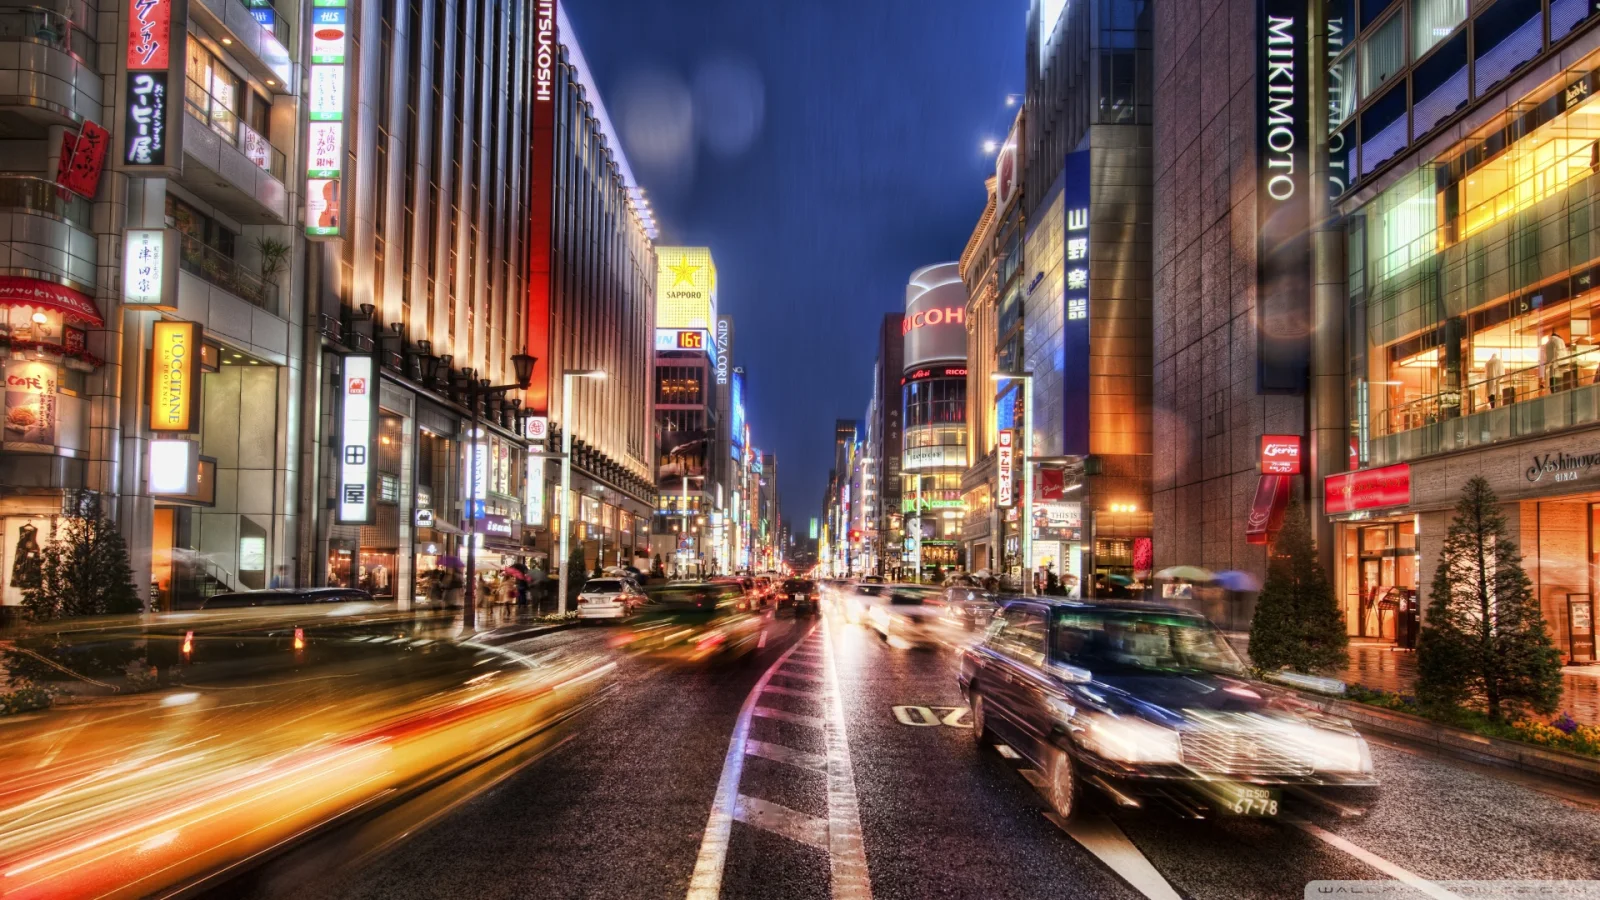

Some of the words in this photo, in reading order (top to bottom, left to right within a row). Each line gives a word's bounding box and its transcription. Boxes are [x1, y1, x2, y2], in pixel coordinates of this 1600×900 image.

[537, 0, 553, 101] ITSUKOSHI
[128, 74, 154, 164] コーヒー屋
[1268, 15, 1295, 201] MIKIMOTO
[666, 291, 702, 299] SAPPORO
[717, 320, 728, 354] GINZA
[902, 307, 964, 337] RICOH
[168, 333, 186, 424] L'OCCITANE
[716, 355, 728, 385] CORE
[1555, 472, 1578, 482] GINZA
[1234, 799, 1278, 816] 67-78
